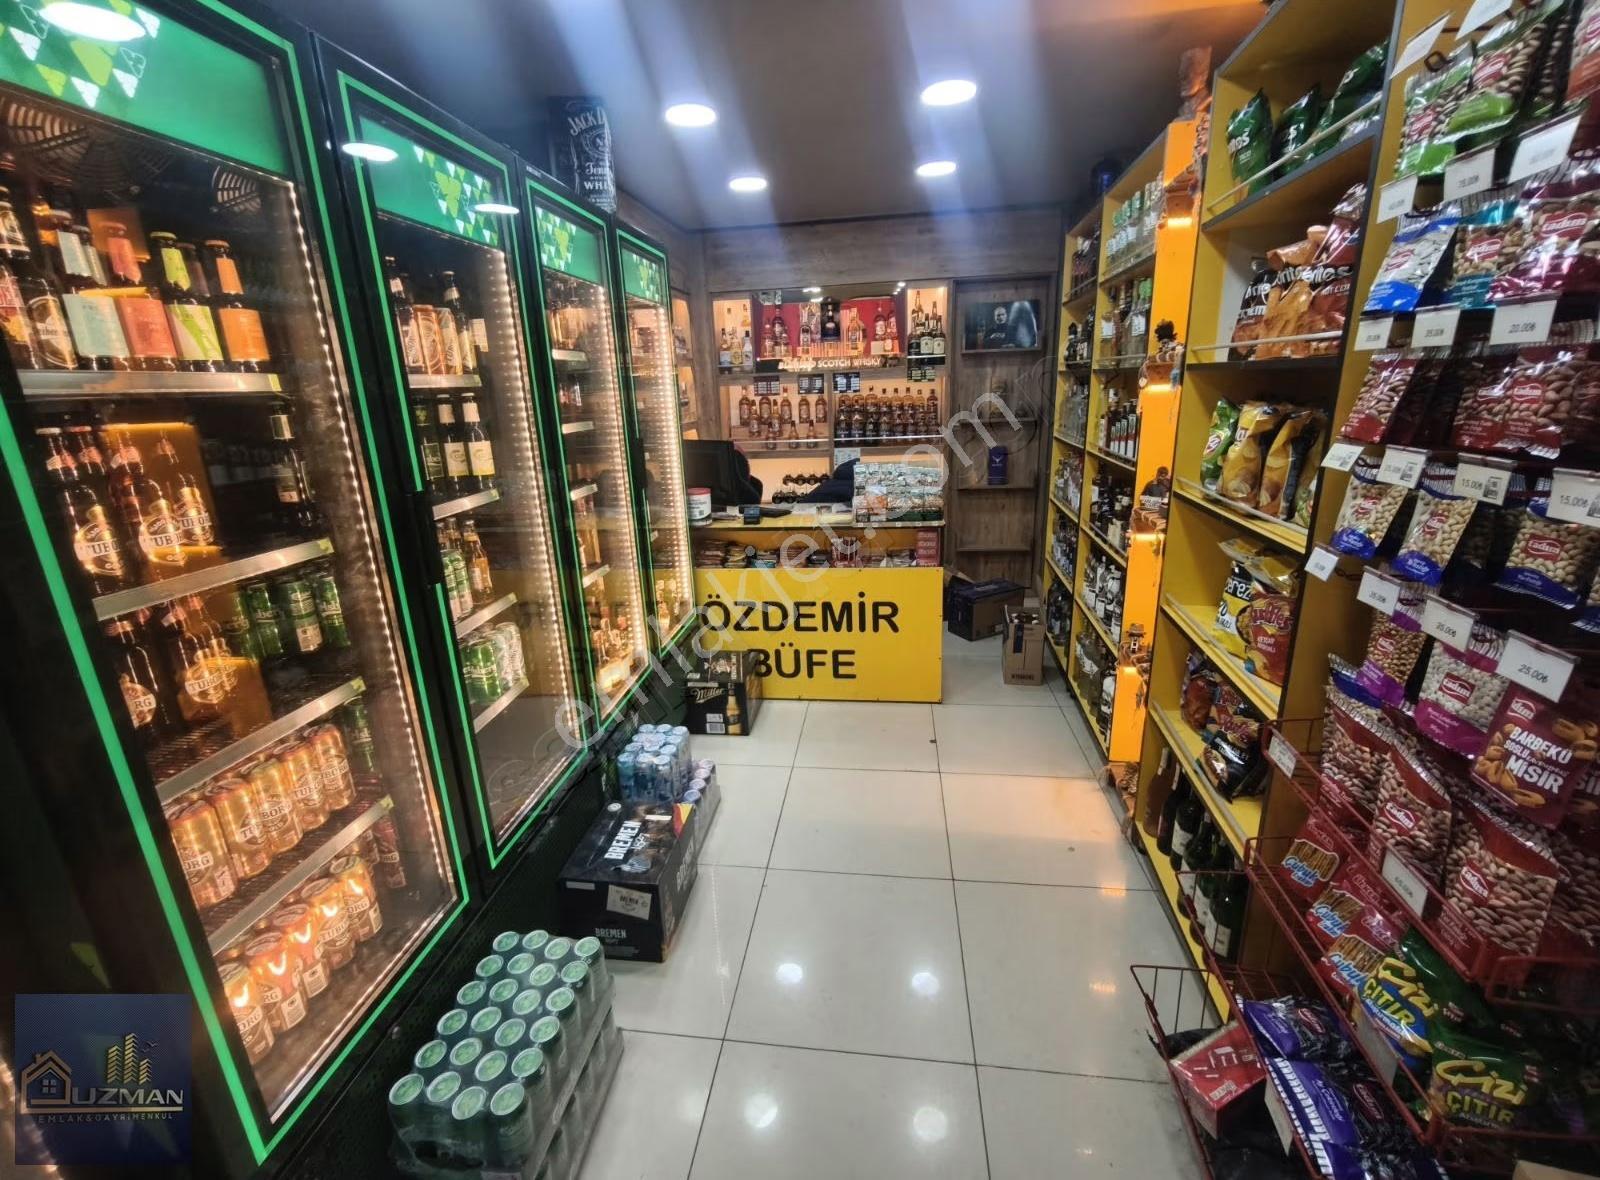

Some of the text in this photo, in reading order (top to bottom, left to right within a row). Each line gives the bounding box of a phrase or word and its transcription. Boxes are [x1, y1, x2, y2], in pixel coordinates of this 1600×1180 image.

[567, 110, 597, 136] JACK
[816, 359, 851, 368] SCOTCH
[700, 591, 900, 633] ÖZDEMİR
[746, 641, 857, 679] BÜFE
